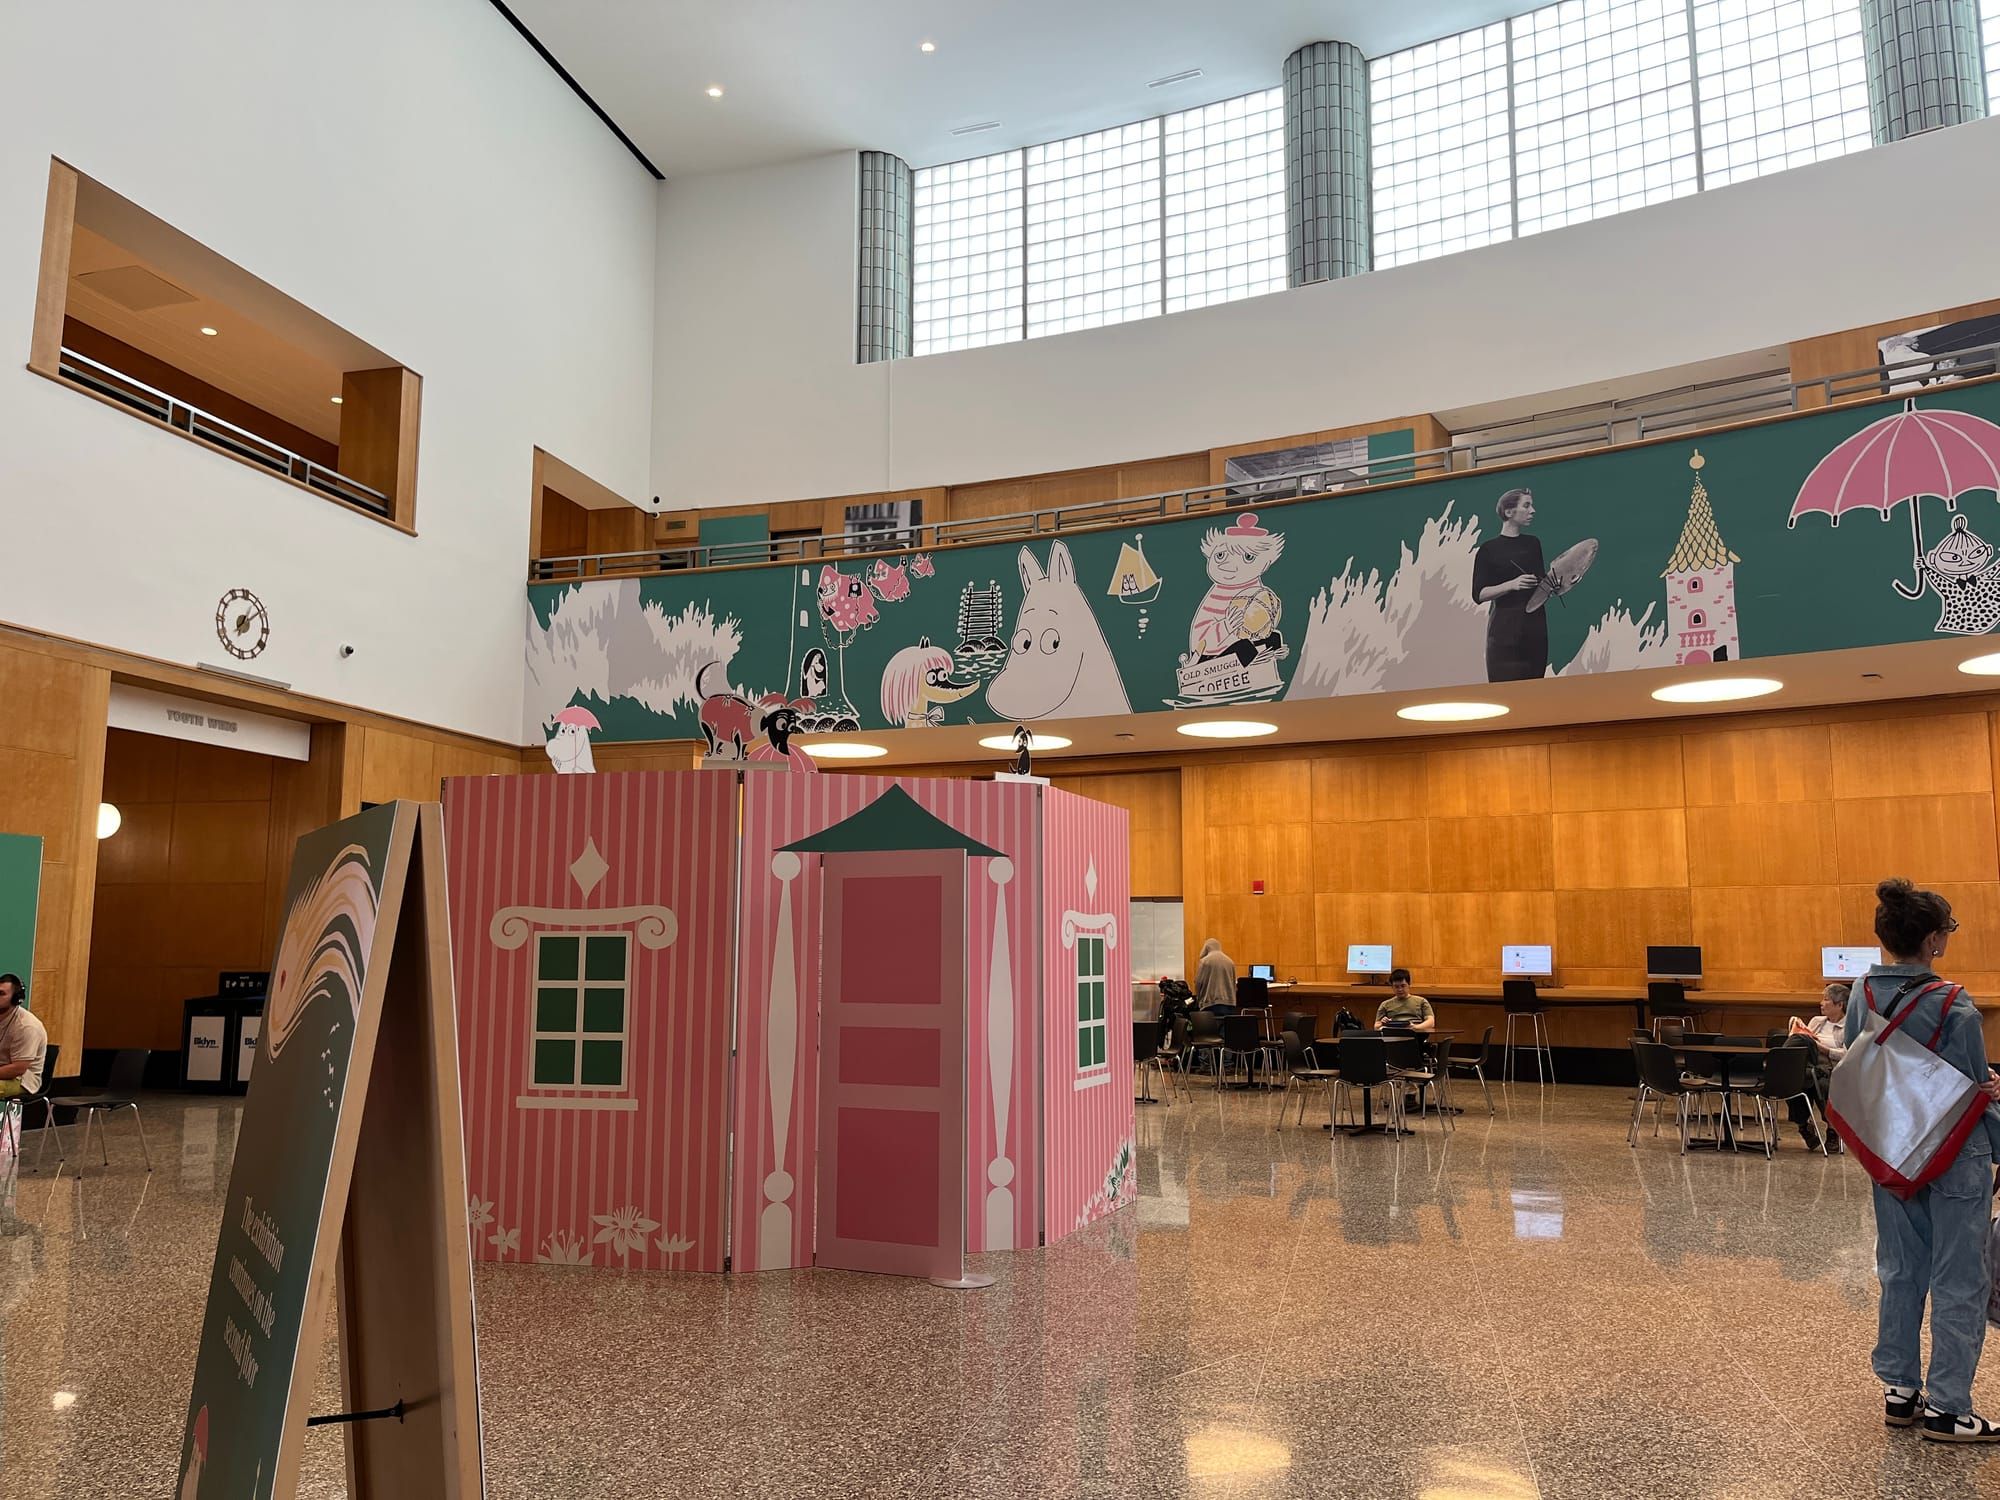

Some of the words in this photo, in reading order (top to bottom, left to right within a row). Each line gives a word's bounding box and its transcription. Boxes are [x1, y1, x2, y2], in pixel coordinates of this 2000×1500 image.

[1183, 671, 1200, 681] OLD
[1198, 671, 1250, 693] COFFEE
[166, 709, 204, 727] YOUTH
[241, 1195, 255, 1237] The
[250, 1210, 284, 1273] exhibition
[229, 1255, 257, 1311] continues
[253, 1290, 265, 1324] on
[261, 1292, 276, 1339] the
[223, 1315, 247, 1367] second
[238, 1334, 259, 1389] floor
